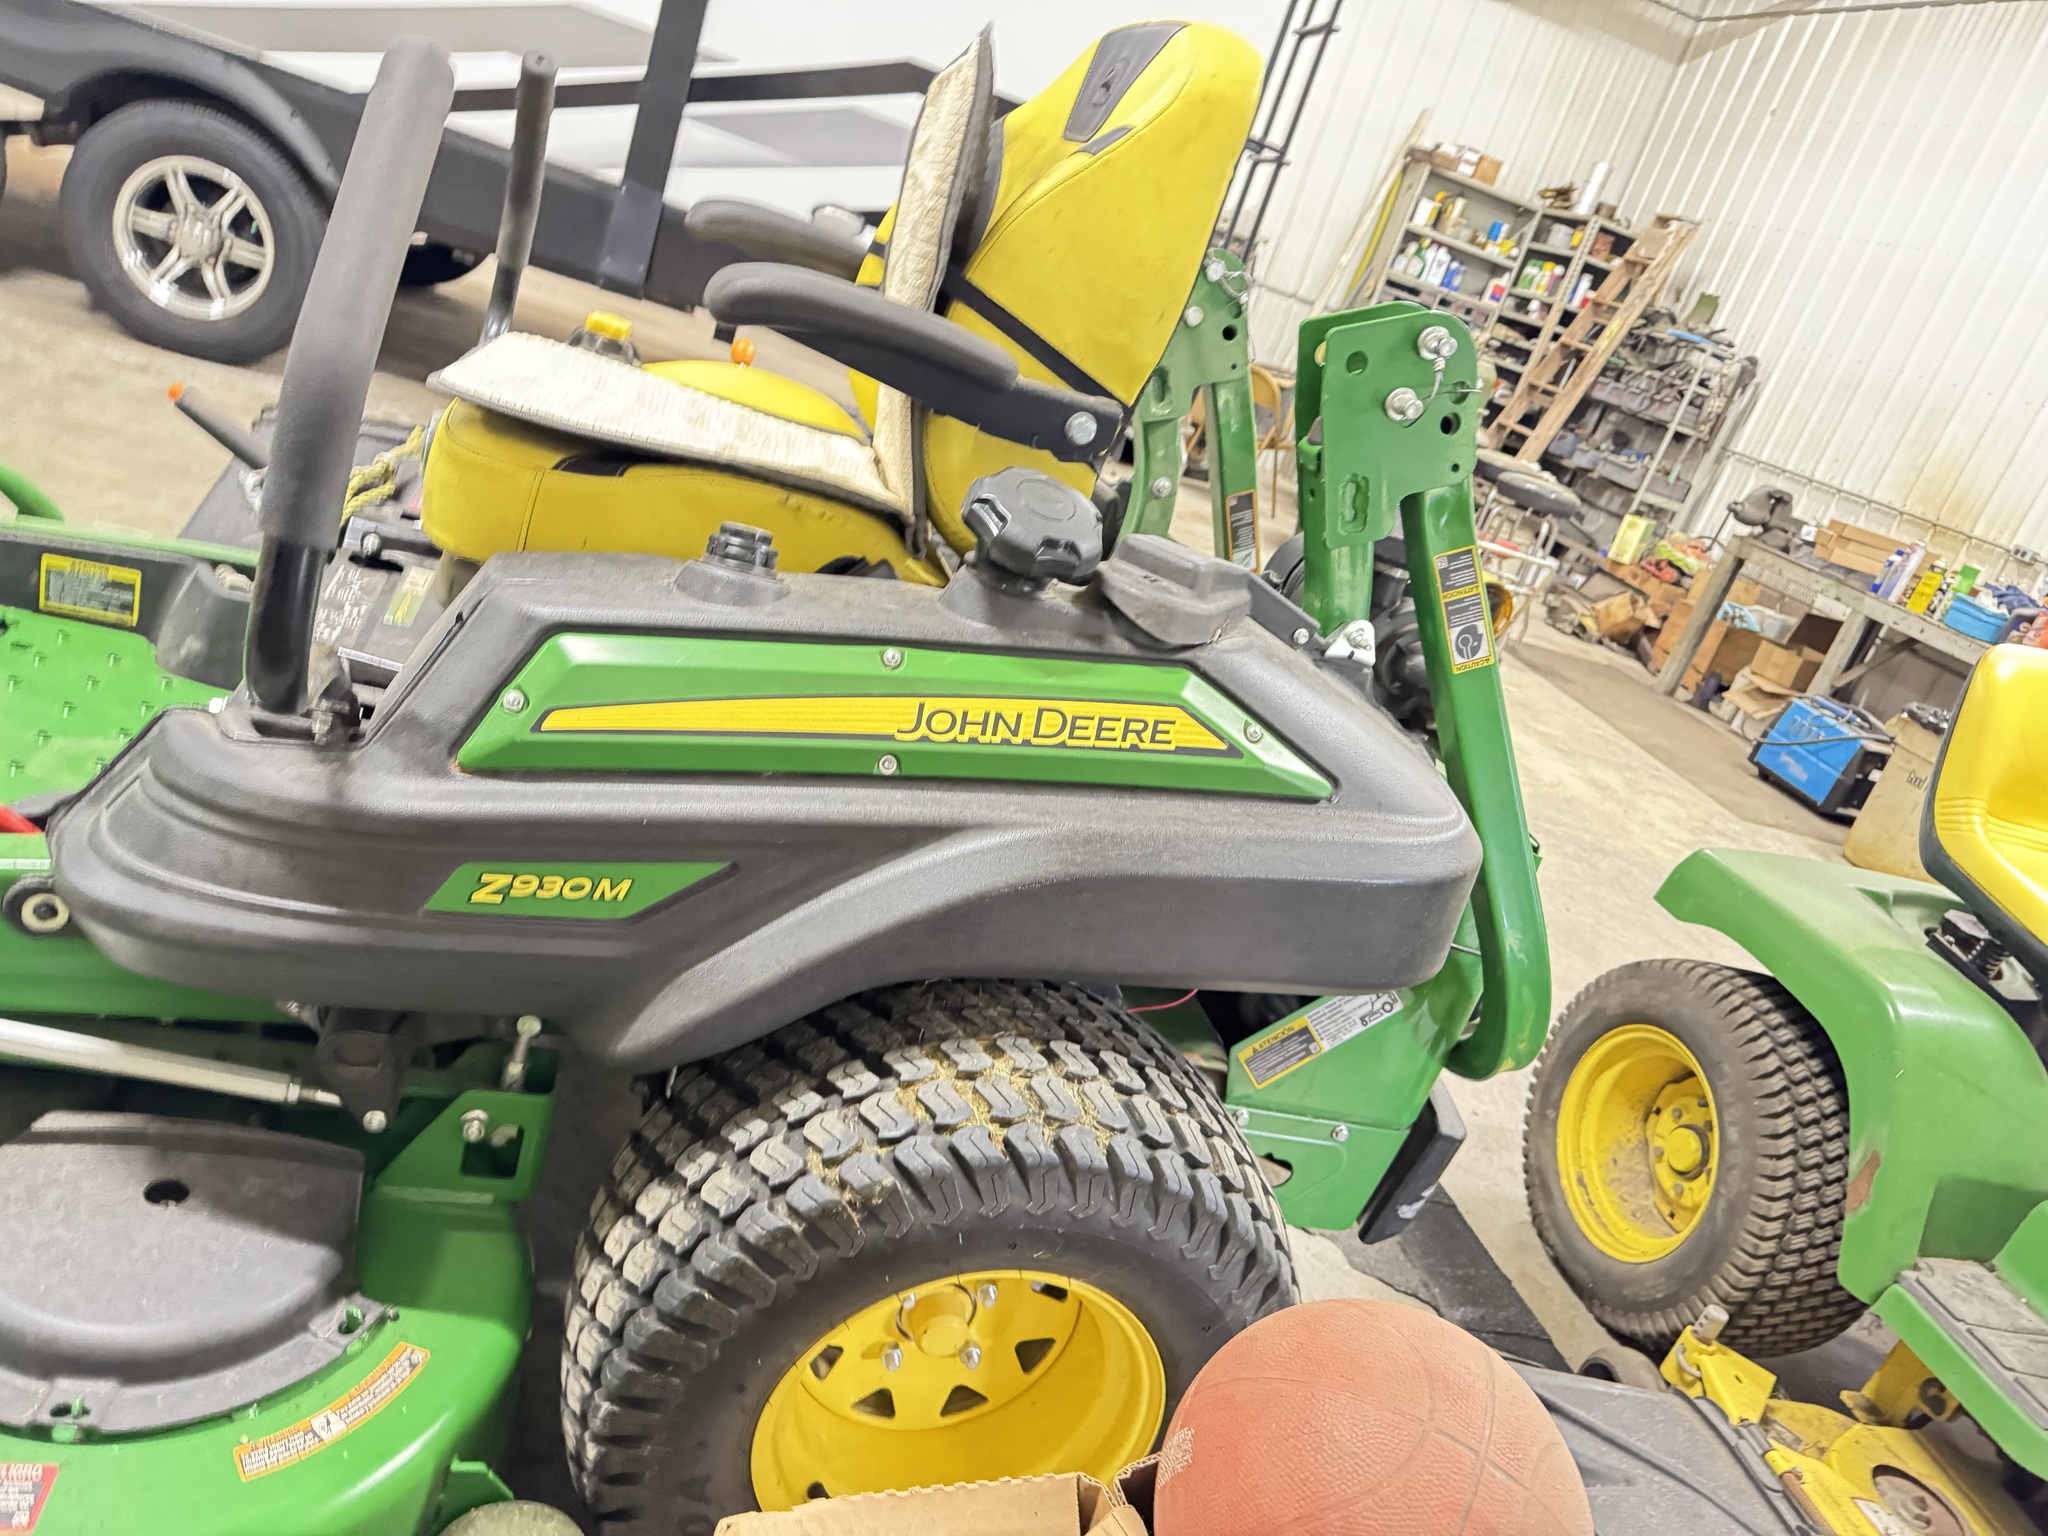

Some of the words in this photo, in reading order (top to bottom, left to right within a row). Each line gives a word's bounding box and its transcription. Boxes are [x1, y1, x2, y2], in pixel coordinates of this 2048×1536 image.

[1456, 660, 1485, 672] CAUTION
[897, 701, 1023, 741] JOHN
[1032, 706, 1177, 746] DEERE
[470, 872, 633, 905] Z930M
